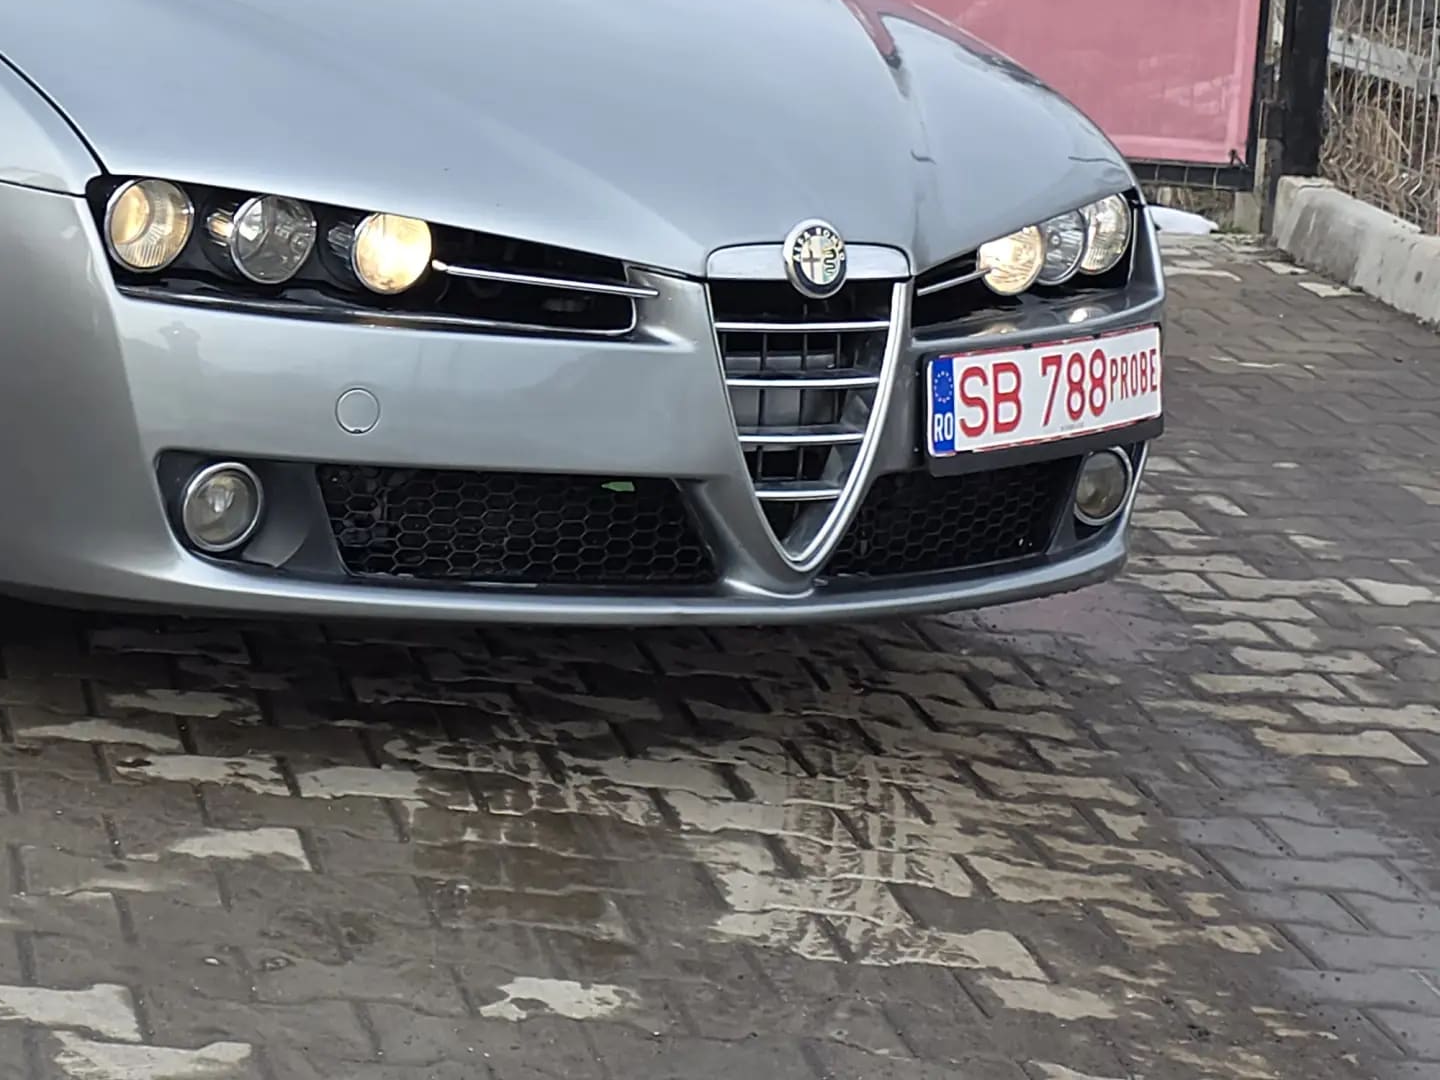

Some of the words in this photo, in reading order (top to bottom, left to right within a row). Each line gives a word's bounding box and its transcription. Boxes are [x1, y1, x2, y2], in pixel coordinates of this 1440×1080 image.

[959, 361, 1022, 438] SB
[1040, 348, 1107, 427] 788
[1110, 348, 1158, 403] PROBE
[933, 412, 954, 443] RO
